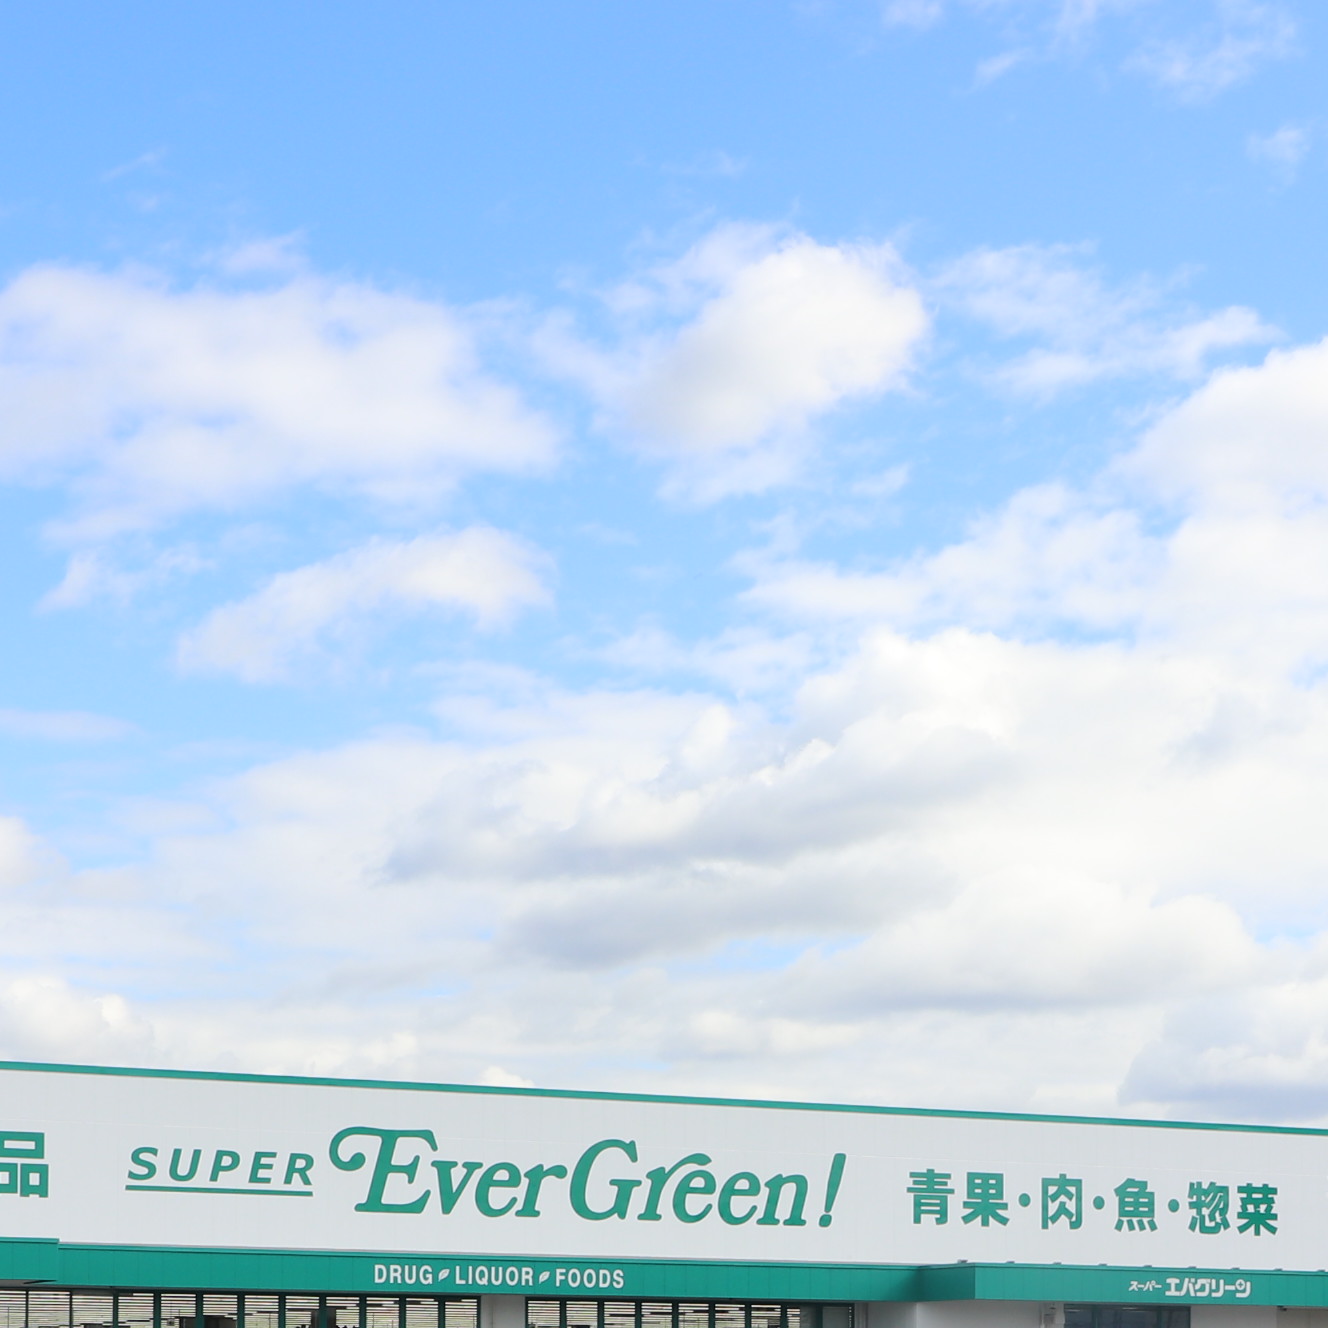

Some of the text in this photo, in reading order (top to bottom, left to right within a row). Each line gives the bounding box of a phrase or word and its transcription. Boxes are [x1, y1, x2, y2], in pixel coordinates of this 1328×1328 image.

[127, 1126, 847, 1228] SUPER EverGreen!
[907, 1168, 1279, 1237] 青果・肉・魚・惣菜
[374, 1265, 625, 1290] DRUG LIQUOR FOODS
[1129, 1278, 1252, 1299] スーパー エバグリーン
